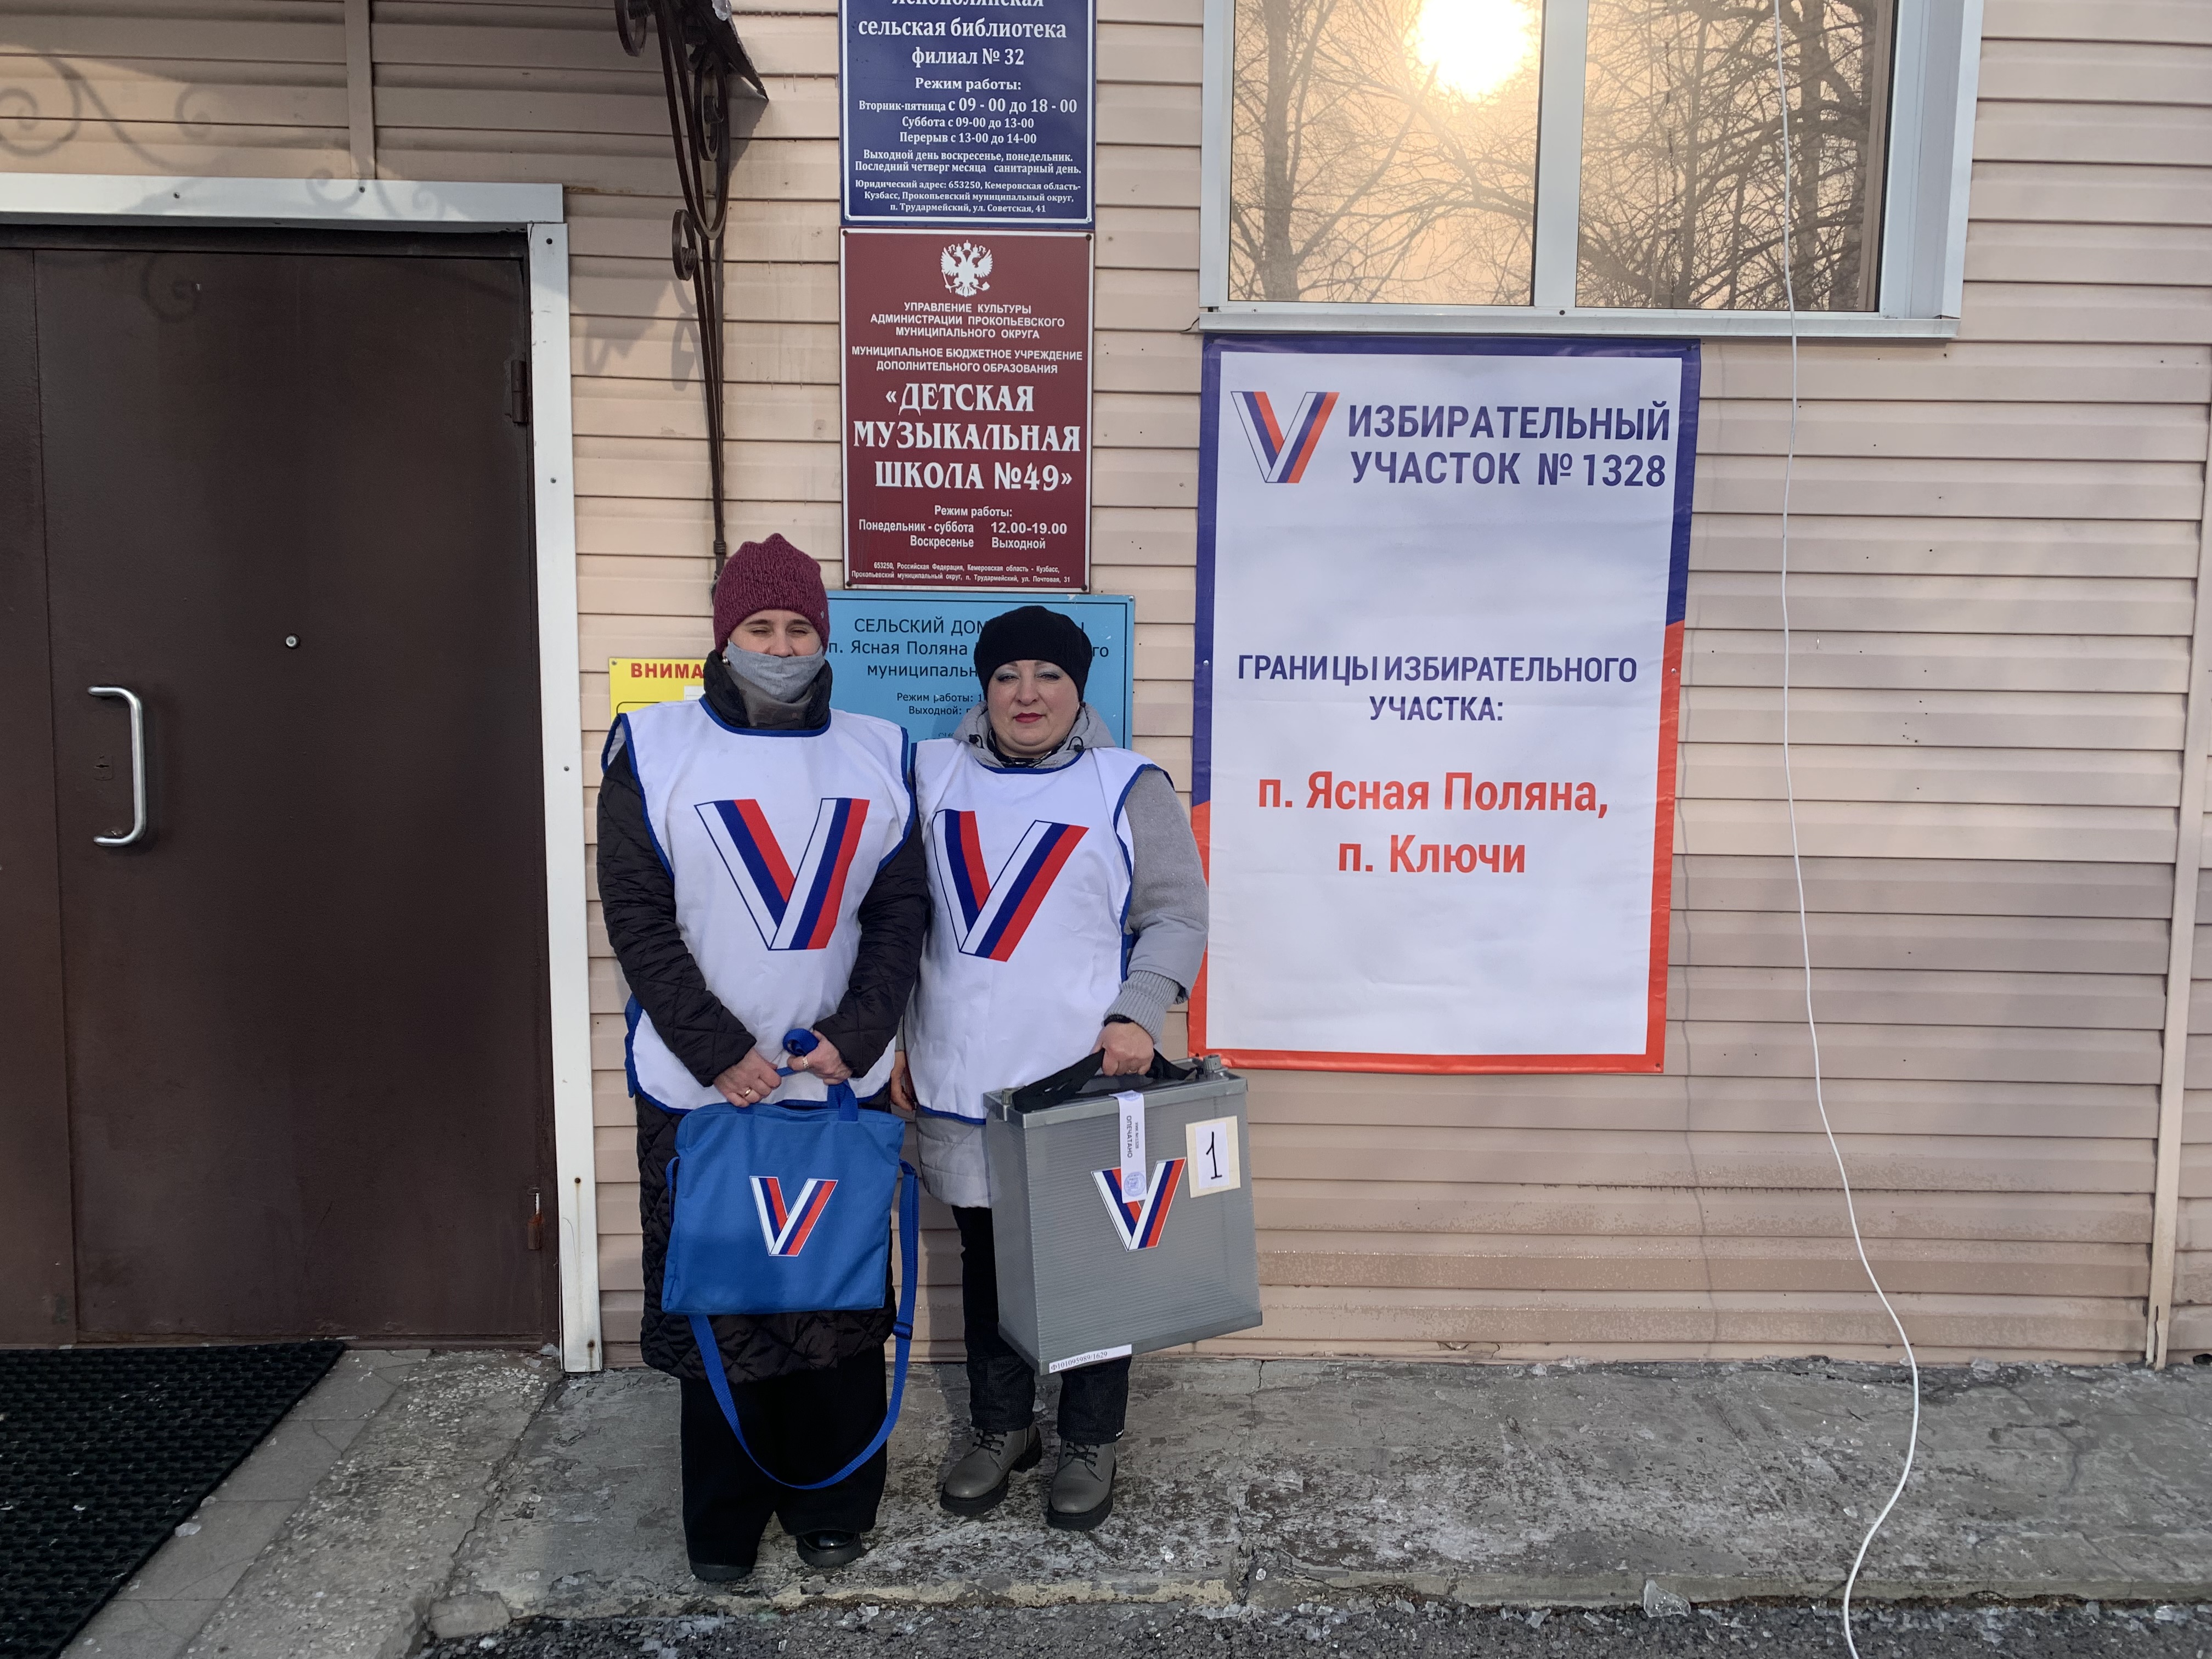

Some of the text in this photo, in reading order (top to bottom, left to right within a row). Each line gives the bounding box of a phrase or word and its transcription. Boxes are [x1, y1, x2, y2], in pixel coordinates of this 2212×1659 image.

[859, 17, 1066, 38] сельская библиотека
[912, 47, 1024, 67] филиал № 32
[916, 77, 1020, 92] Режим работы:
[859, 100, 946, 112] Вторник-пятница
[949, 101, 955, 111] с
[959, 98, 975, 111] 09
[989, 98, 1005, 111] 00
[1009, 102, 1026, 114] до
[1031, 99, 1047, 112] 18
[1060, 99, 1077, 112] 00
[902, 116, 945, 129] Суббота
[956, 117, 985, 127] 09-00
[988, 120, 1001, 129] до
[1005, 118, 1034, 128] 13-00
[900, 132, 948, 145] Перерыв
[959, 133, 988, 143] 13-00
[991, 136, 1004, 145] до
[1007, 133, 1036, 144] 14-00
[864, 149, 1073, 162] Выходной день воскресенье, понедельник.
[855, 161, 1081, 175] Последний четверг месяца санитарный день.
[856, 180, 917, 189] Юридический
[949, 181, 983, 189] 653250,
[985, 182, 1041, 191] Кемеровская
[865, 191, 900, 200] Кузбасс,
[902, 191, 970, 201] Прокопьевский
[973, 194, 1045, 202] муниципальный
[900, 203, 970, 212] Трудармейский,
[988, 204, 1034, 213] Советская,
[904, 302, 1031, 314] УПРАВЛЕНИЕ КУЛЬТУРЫ
[871, 314, 1064, 326] АДМИНИСТРАЦИИ ПРОКОПЬЕВСКОГО
[896, 327, 1040, 338] МУНИЦИПАЛЬНОГО ОКРУГА
[852, 346, 1082, 361] МУНИЦИПАЛЬНОЕ БЮДЖЕТНОЕ УЧРЕЖДЕНИЕ
[877, 361, 1057, 373] ДОПОЛНИТЕЛЬНОГО ОБРАЗОВАНИЯ
[886, 383, 1034, 416] «ДЕТСКАЯ
[1349, 400, 1669, 440] ИЗБИРАТЕЛЬНЫЙ
[854, 421, 1080, 451] МУЗЫКАЛЬНАЯ
[875, 461, 1072, 491] ШКОЛА №49»
[1351, 452, 1665, 487] УЧАСТОК № 1328
[935, 505, 1012, 518] Режим работы:
[859, 519, 925, 532] Понедельник
[934, 521, 973, 534] суббота
[991, 522, 1066, 534] 12.00-19.00
[911, 535, 1045, 550] Воскресенье Выходной
[855, 617, 943, 633] СЕЛЬСКИЙ
[829, 643, 843, 653] п.
[851, 640, 899, 654] Ясная
[907, 641, 967, 655] Поляна
[631, 663, 703, 678] ВНИМА
[867, 664, 977, 679] муниципальн
[1239, 655, 1637, 686] ГРАНИЦЫ ИЗБИРАТЕЛЬНОГО
[898, 693, 929, 701] Режим
[934, 693, 973, 703] работы:
[909, 706, 961, 715] Выходной:
[1369, 696, 1503, 720] УЧАСТКА:
[1259, 771, 1607, 818] п. Ясная Поляна,
[1339, 835, 1525, 873] п. Ключи
[1206, 1132, 1222, 1180] 1
[1051, 1351, 1108, 1370] Ф101095989/1629
